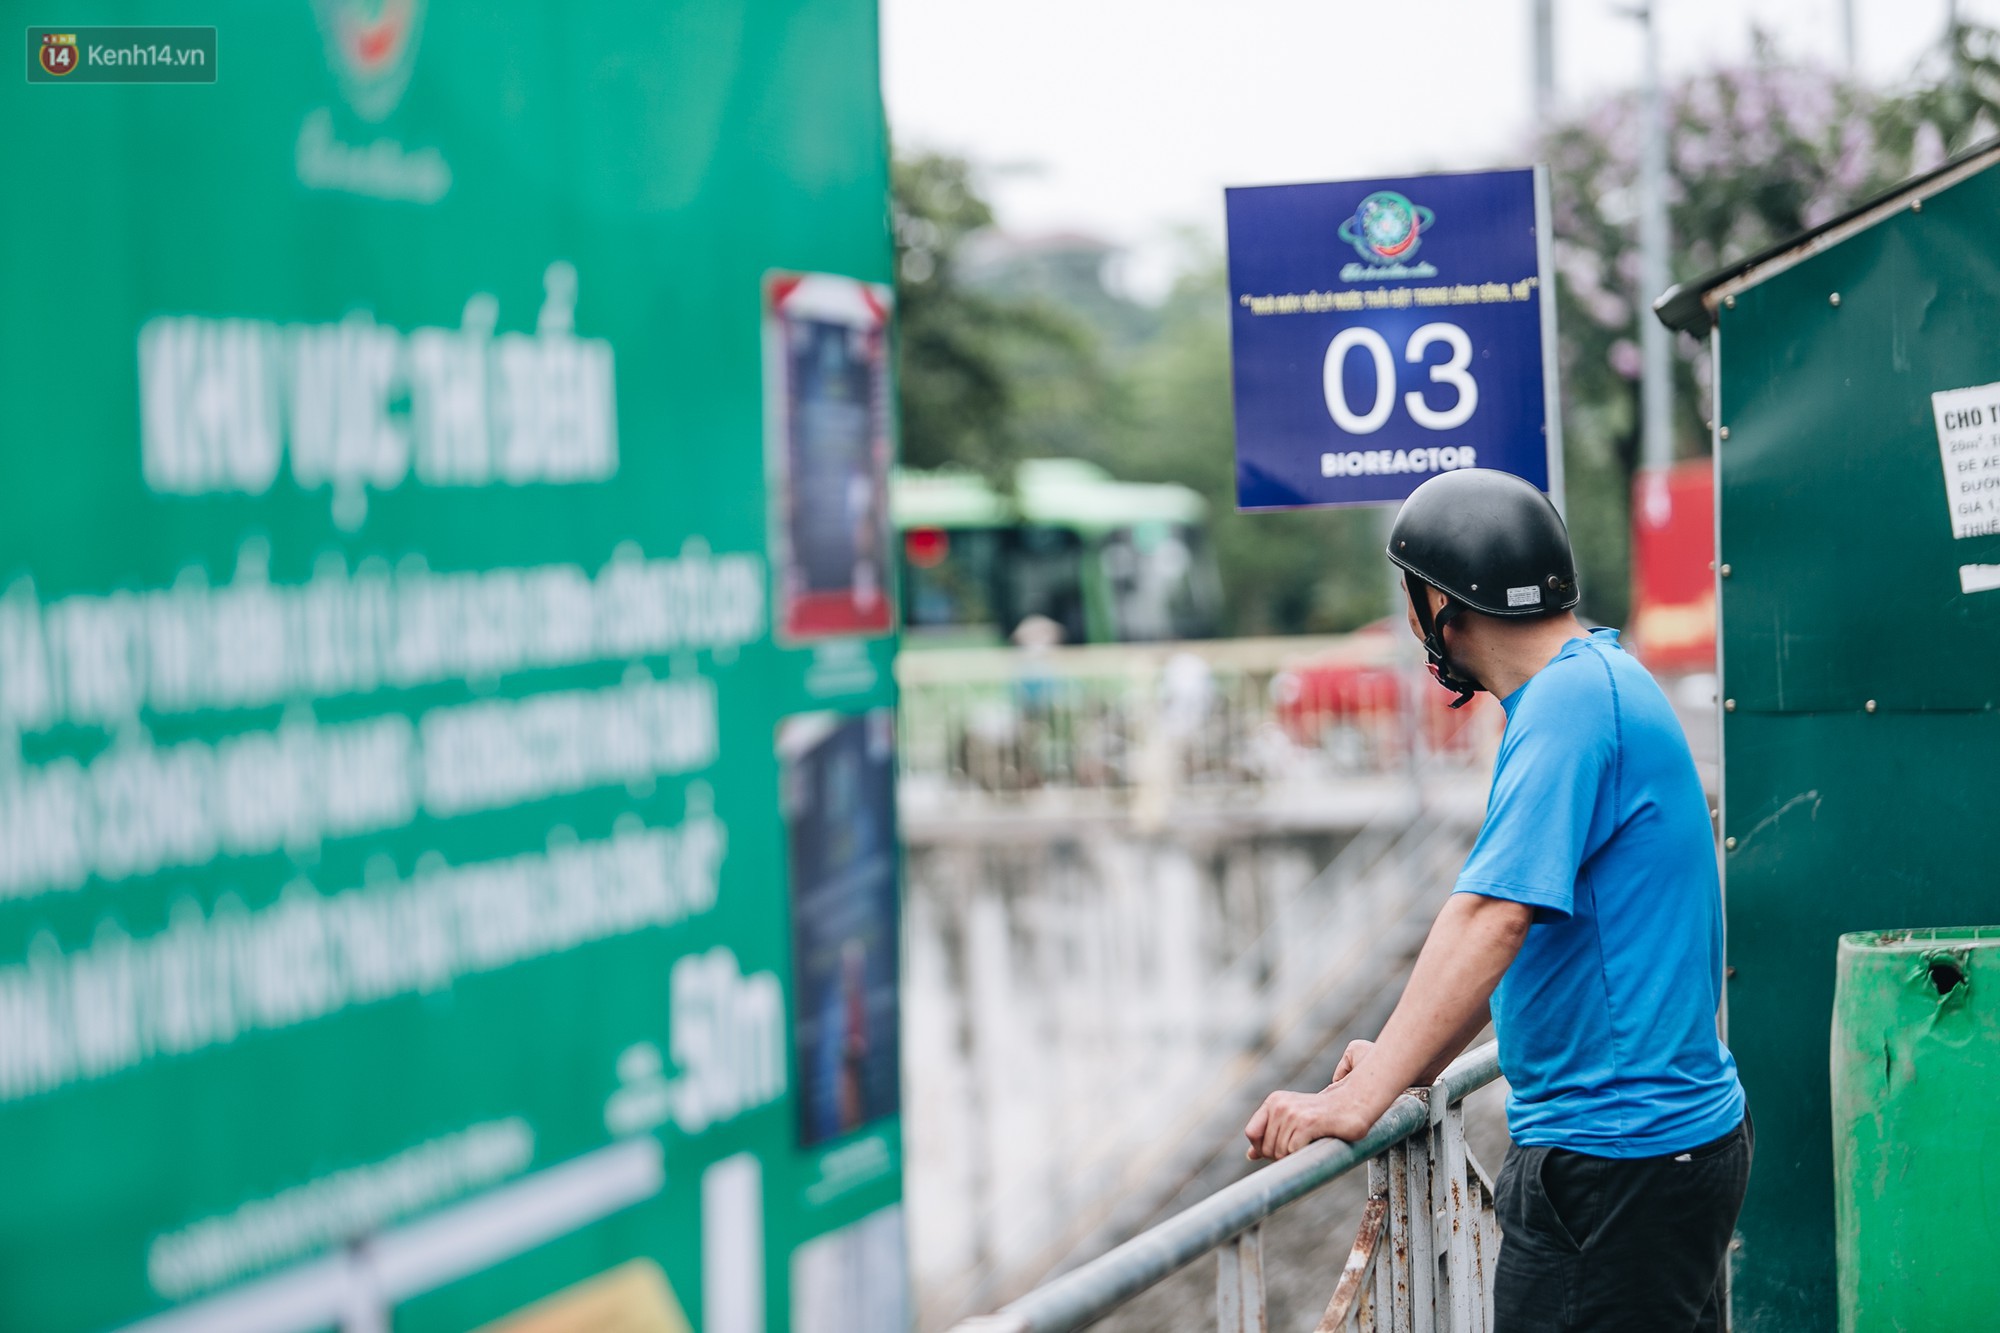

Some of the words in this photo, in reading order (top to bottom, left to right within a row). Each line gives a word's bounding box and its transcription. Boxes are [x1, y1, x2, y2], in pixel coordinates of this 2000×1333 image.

[1323, 322, 1478, 435] 03
[1944, 407, 1982, 431] CHO
[1321, 446, 1477, 478] BIOREACTOR
